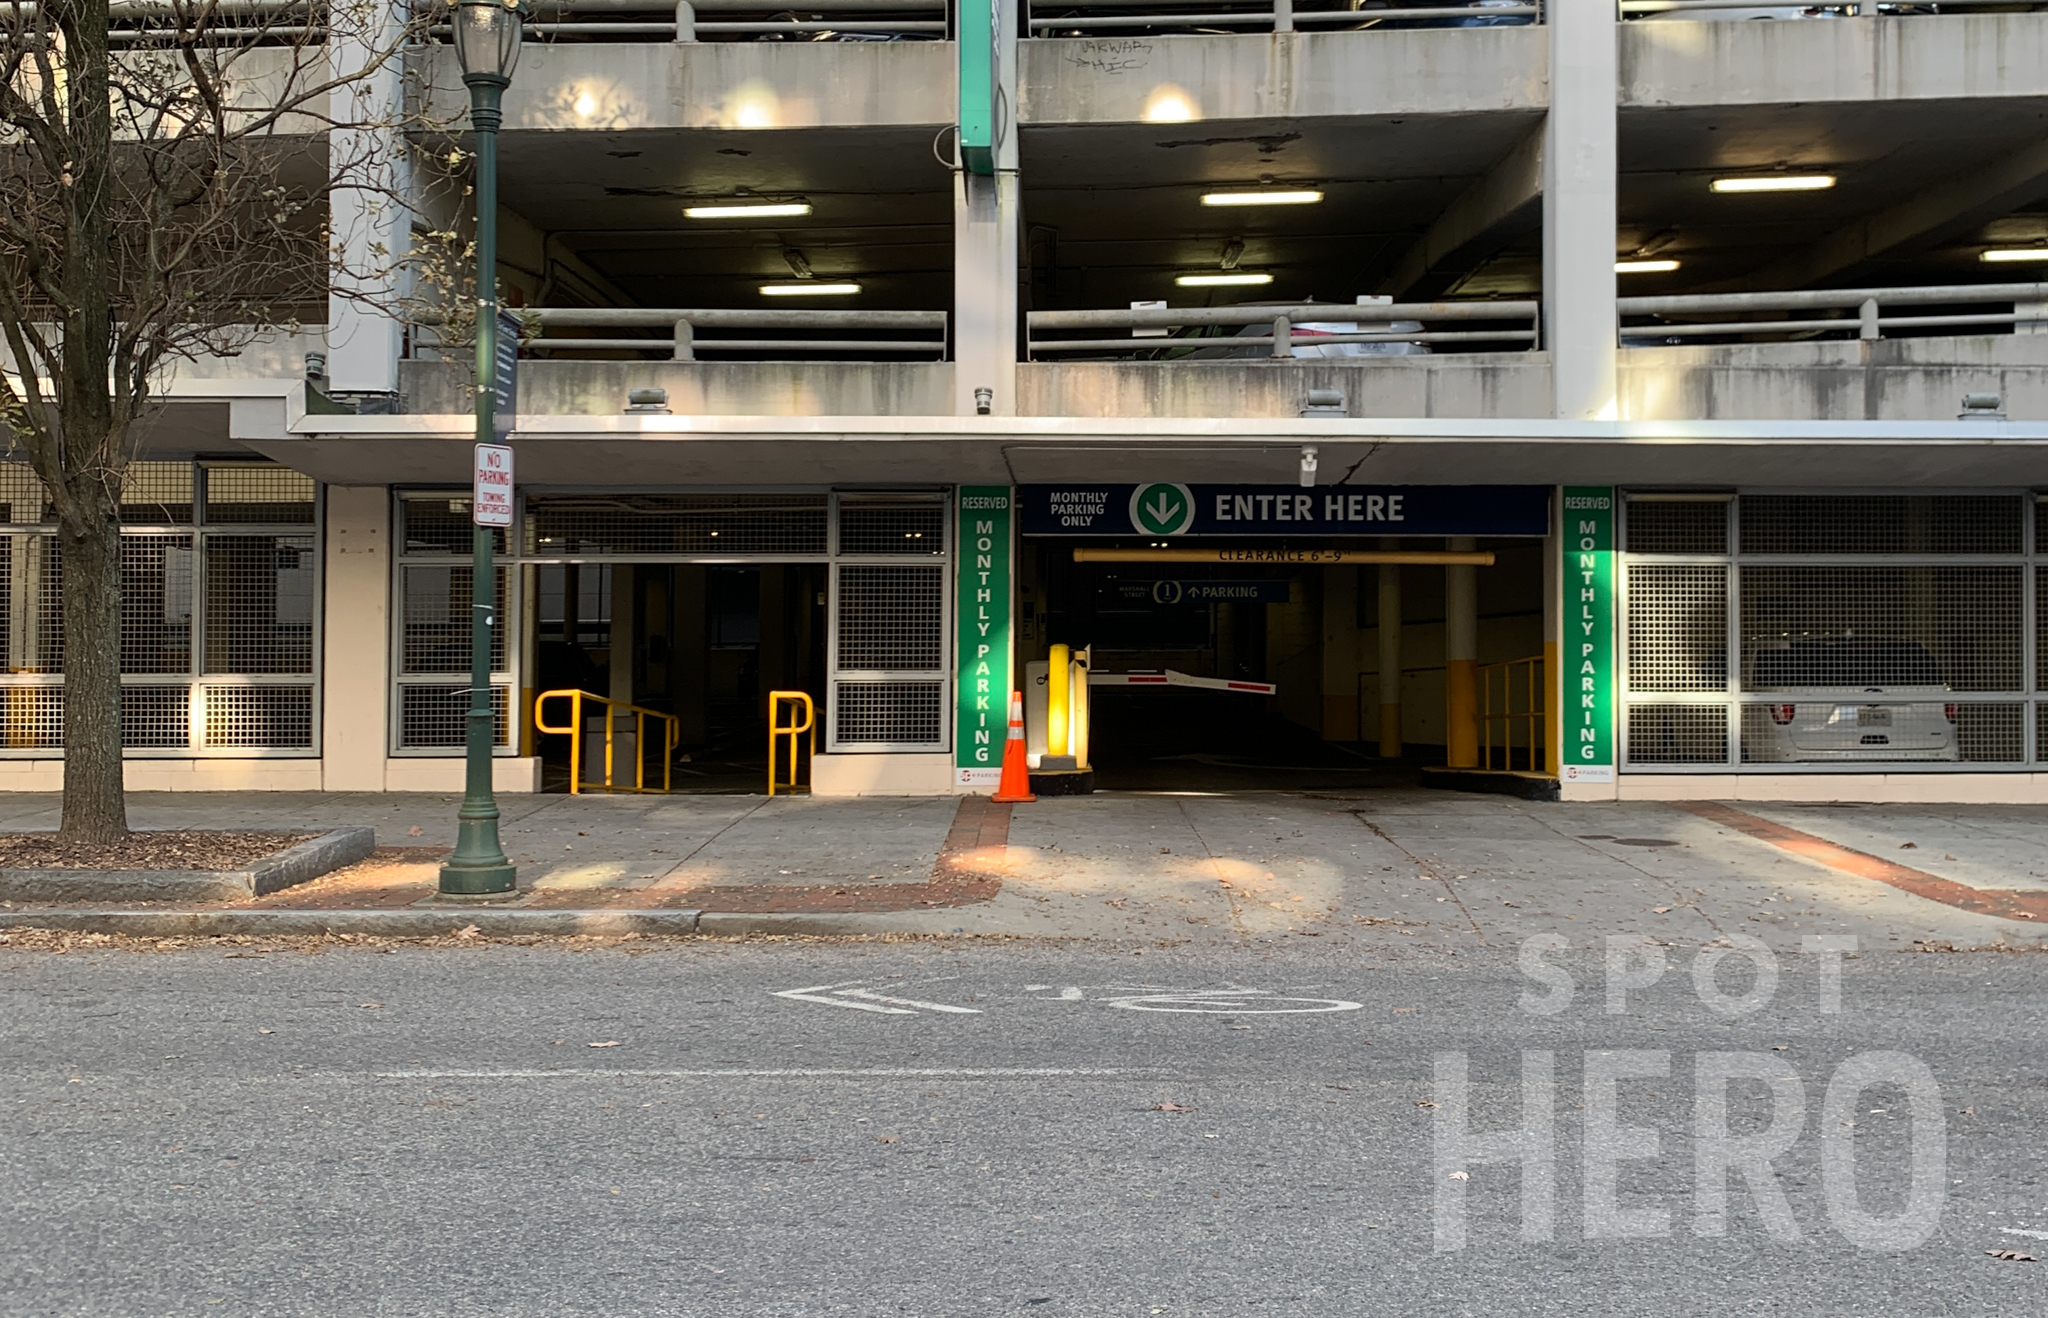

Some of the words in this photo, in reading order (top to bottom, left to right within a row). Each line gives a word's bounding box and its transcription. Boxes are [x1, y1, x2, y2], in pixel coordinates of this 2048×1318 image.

[487, 453, 501, 468] NO
[479, 470, 509, 485] PARKING
[482, 492, 505, 503] TOWING
[962, 497, 1008, 509] RESERVED
[1050, 492, 1108, 503] MONTHLY
[1565, 497, 1610, 509] RESERVED
[477, 503, 511, 515] ENFORCED
[1051, 504, 1105, 514] PARKING
[1216, 495, 1314, 521] ENTER
[1325, 495, 1405, 521] HERE
[1061, 516, 1093, 526] ONLY
[1219, 550, 1305, 561] CLEARANCE
[976, 521, 993, 637] MONTHLY
[1579, 520, 1596, 636] MONTHLY
[1202, 587, 1259, 598] PARKING
[975, 644, 991, 762] PARKING
[1580, 643, 1596, 760] PARKING
